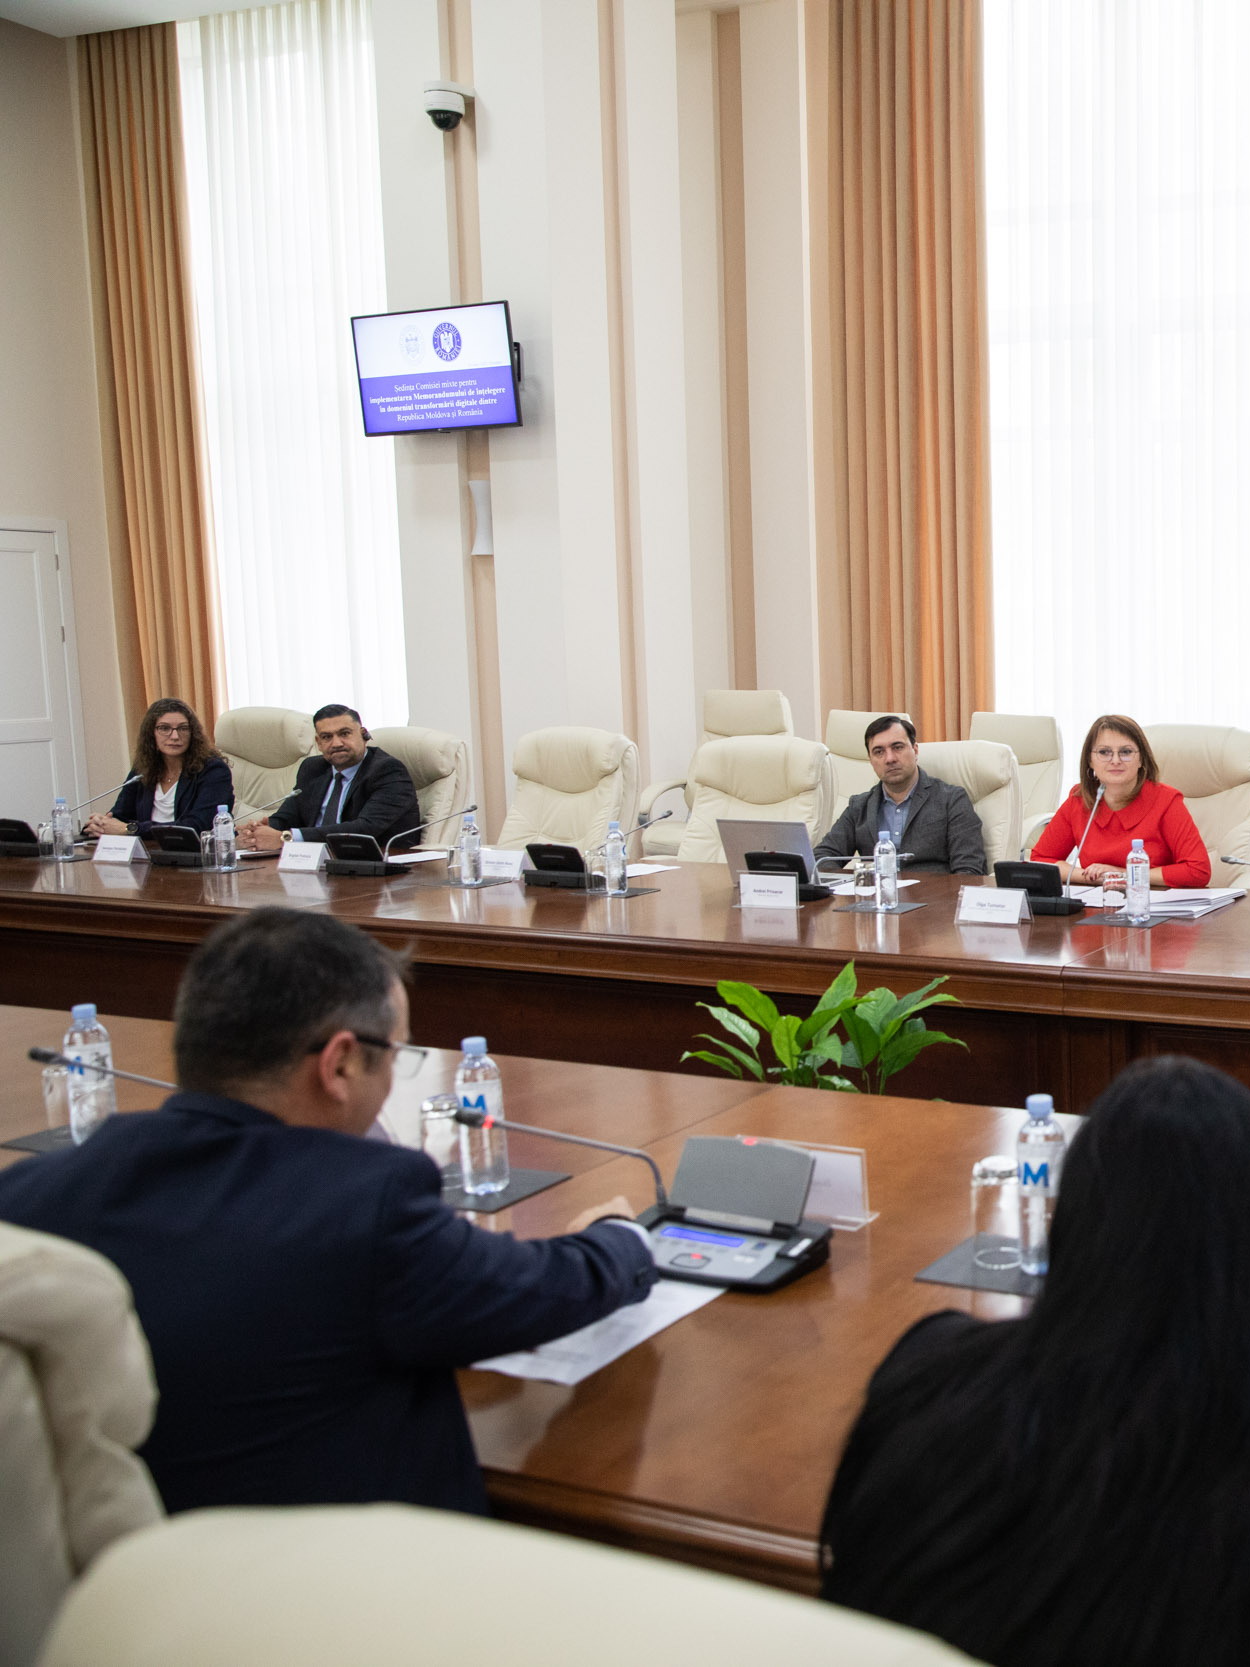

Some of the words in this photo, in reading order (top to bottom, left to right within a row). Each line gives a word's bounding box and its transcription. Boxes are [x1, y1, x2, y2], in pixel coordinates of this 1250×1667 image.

[415, 381, 440, 390] Comisiei
[441, 380, 458, 388] mixte
[458, 379, 477, 388] pentru
[413, 389, 467, 400] Memorandumului
[467, 388, 475, 396] de
[386, 403, 414, 412] domeniul
[455, 398, 478, 408] digitale
[478, 397, 497, 405] dintre
[397, 412, 424, 423] Republica
[425, 410, 451, 419] Moldova
[1017, 1161, 1049, 1188] M
